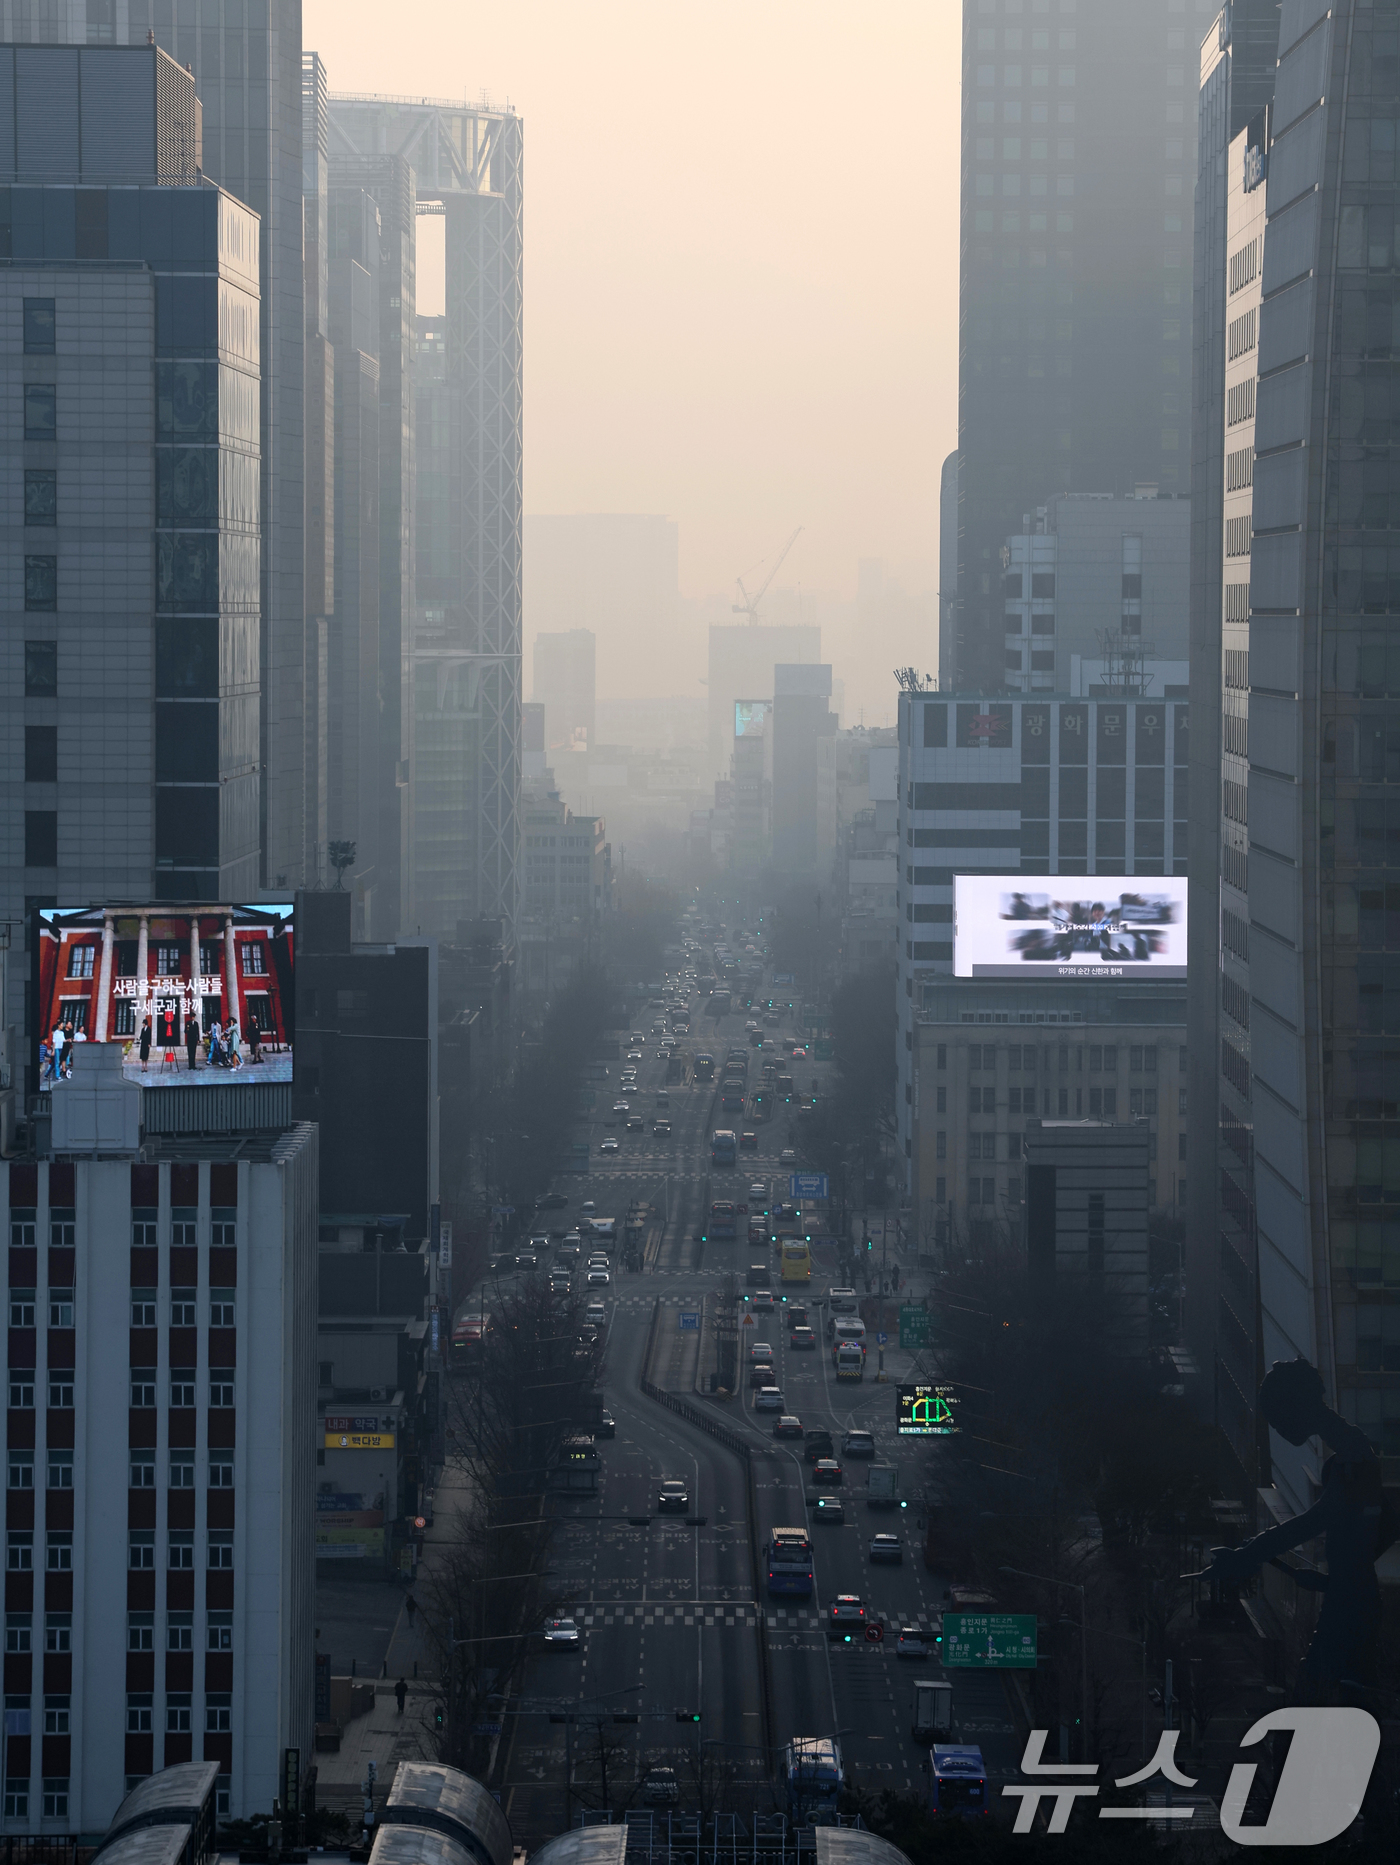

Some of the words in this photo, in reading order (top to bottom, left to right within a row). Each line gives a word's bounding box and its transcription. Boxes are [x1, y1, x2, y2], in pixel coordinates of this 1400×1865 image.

[1058, 967, 1076, 975] 위기의
[1077, 967, 1090, 975] 순간
[1091, 967, 1109, 975] 신한과
[1110, 967, 1123, 975] 함께
[113, 977, 223, 997] 사람을구하는사람들
[129, 999, 177, 1016] 구세군과
[179, 998, 203, 1015] 함께
[328, 1418, 349, 1430] 내과
[355, 1418, 376, 1430] 약국
[352, 1436, 381, 1446] 백다방
[960, 1617, 988, 1626] 흥인지문
[948, 1643, 970, 1652] 광화문
